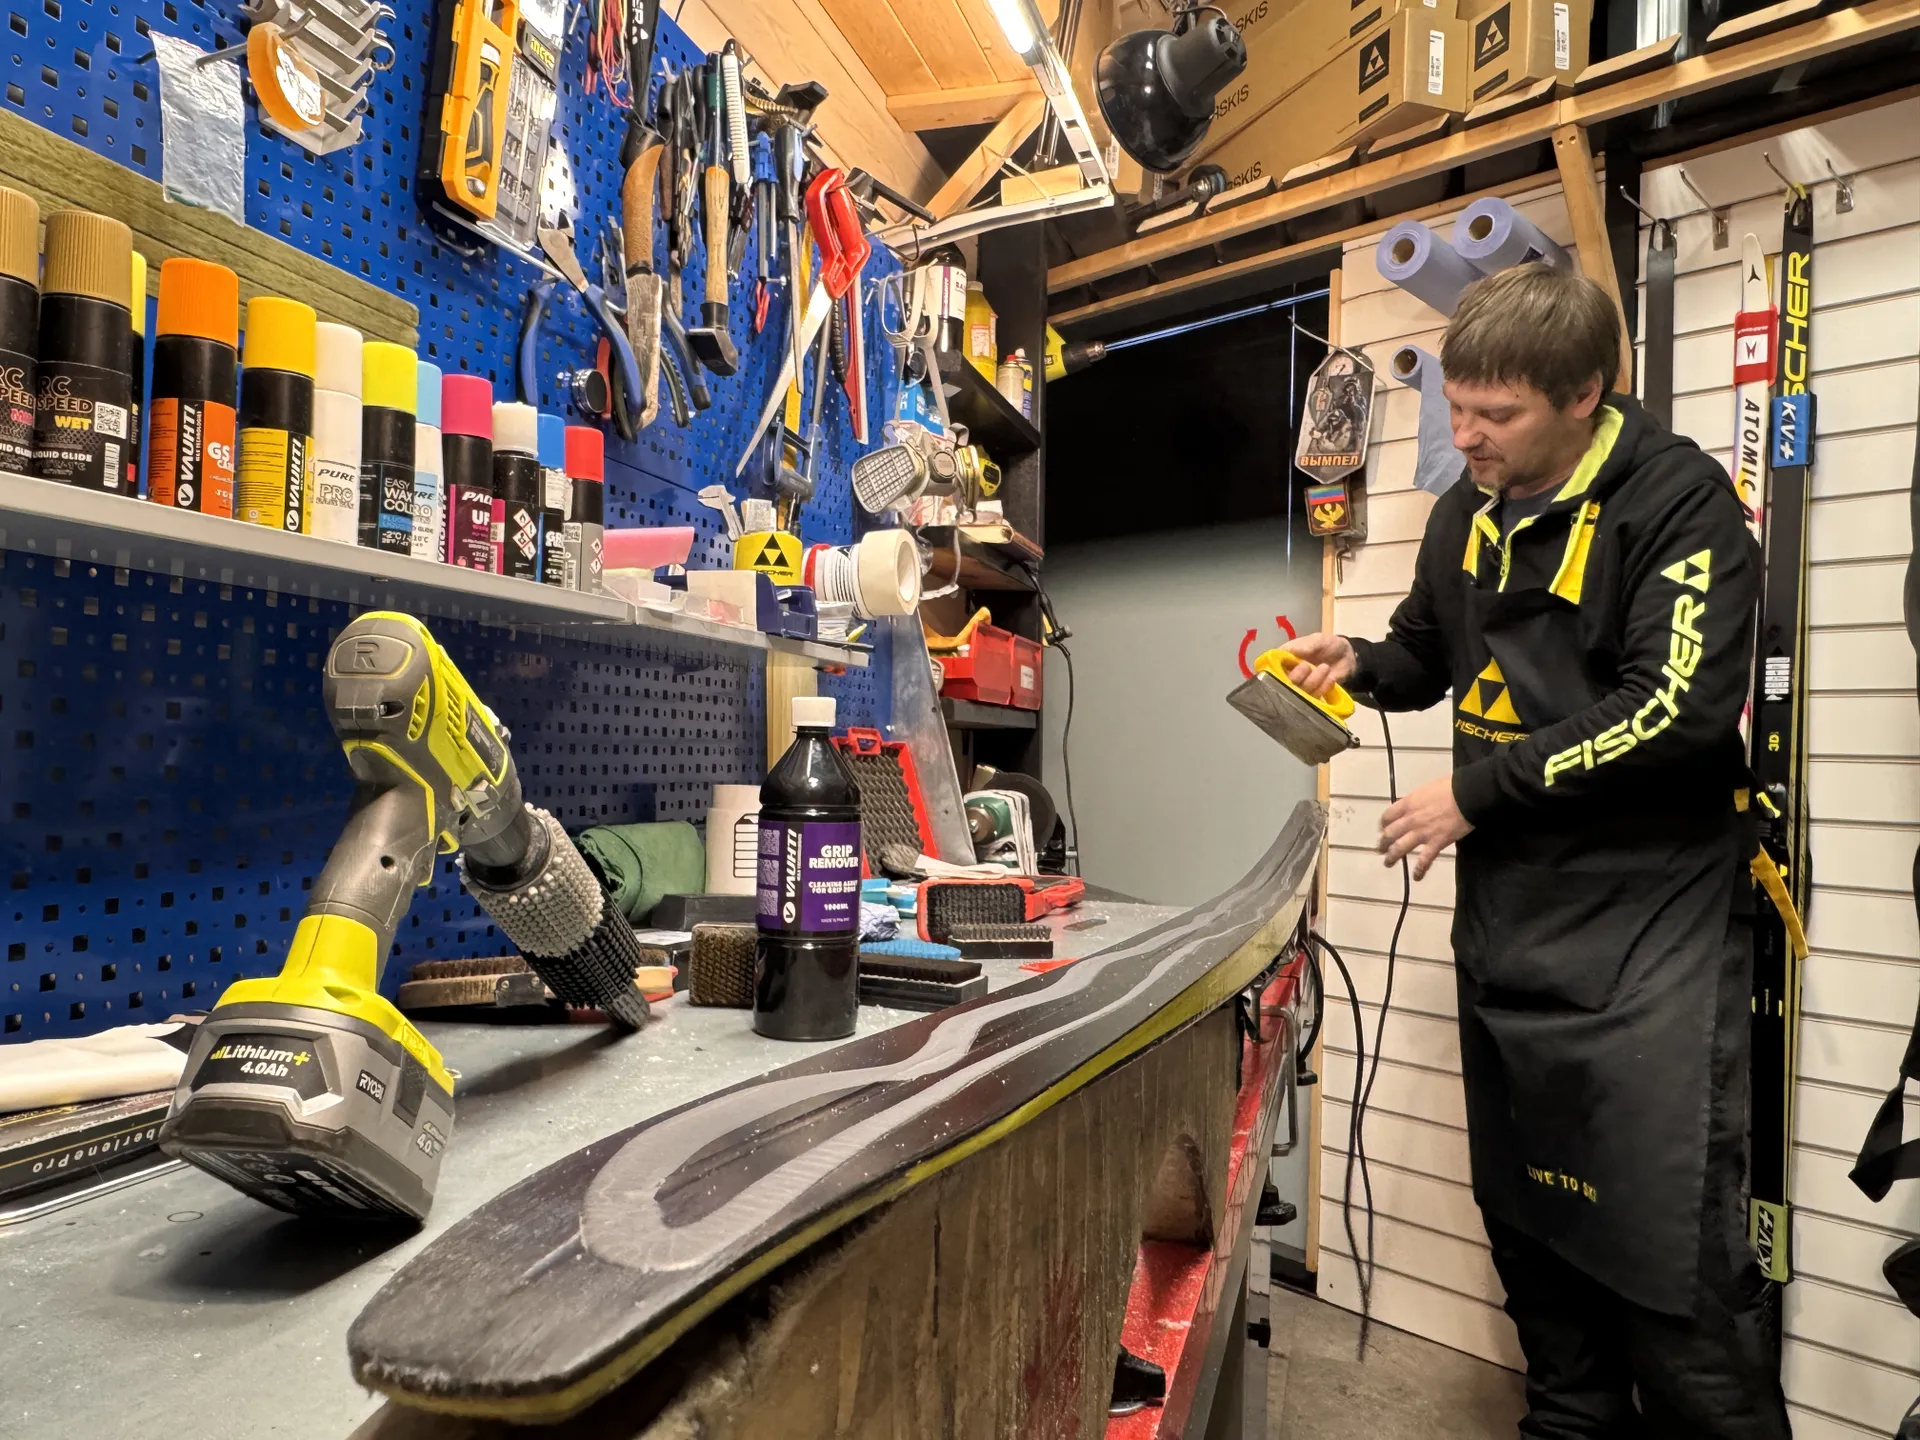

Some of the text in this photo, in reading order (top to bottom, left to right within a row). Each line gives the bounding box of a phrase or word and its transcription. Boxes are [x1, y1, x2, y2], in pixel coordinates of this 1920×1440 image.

[37, 396, 93, 413] SPEED
[54, 415, 92, 431] WET
[180, 405, 196, 481] VAUHTI
[207, 441, 230, 462] GS
[1740, 398, 1760, 492] ATOMIC
[61, 451, 92, 463] GLIDE
[1301, 455, 1359, 467] ВЫМПЕЛ
[289, 438, 302, 508] VAUHTI
[318, 468, 355, 483] PURE
[384, 477, 410, 490] EASY
[320, 483, 353, 504] PRO
[384, 487, 412, 503] WAX
[1544, 594, 1706, 787] FISCHER
[821, 844, 854, 858] GRIP
[785, 828, 798, 898] VAUHTI
[808, 856, 859, 869] REMOVER
[240, 1061, 289, 1077] 4.0Ah
[360, 1071, 386, 1100] RYOBI
[1560, 1173, 1579, 1192] TO
[1757, 1210, 1773, 1274] KV+
